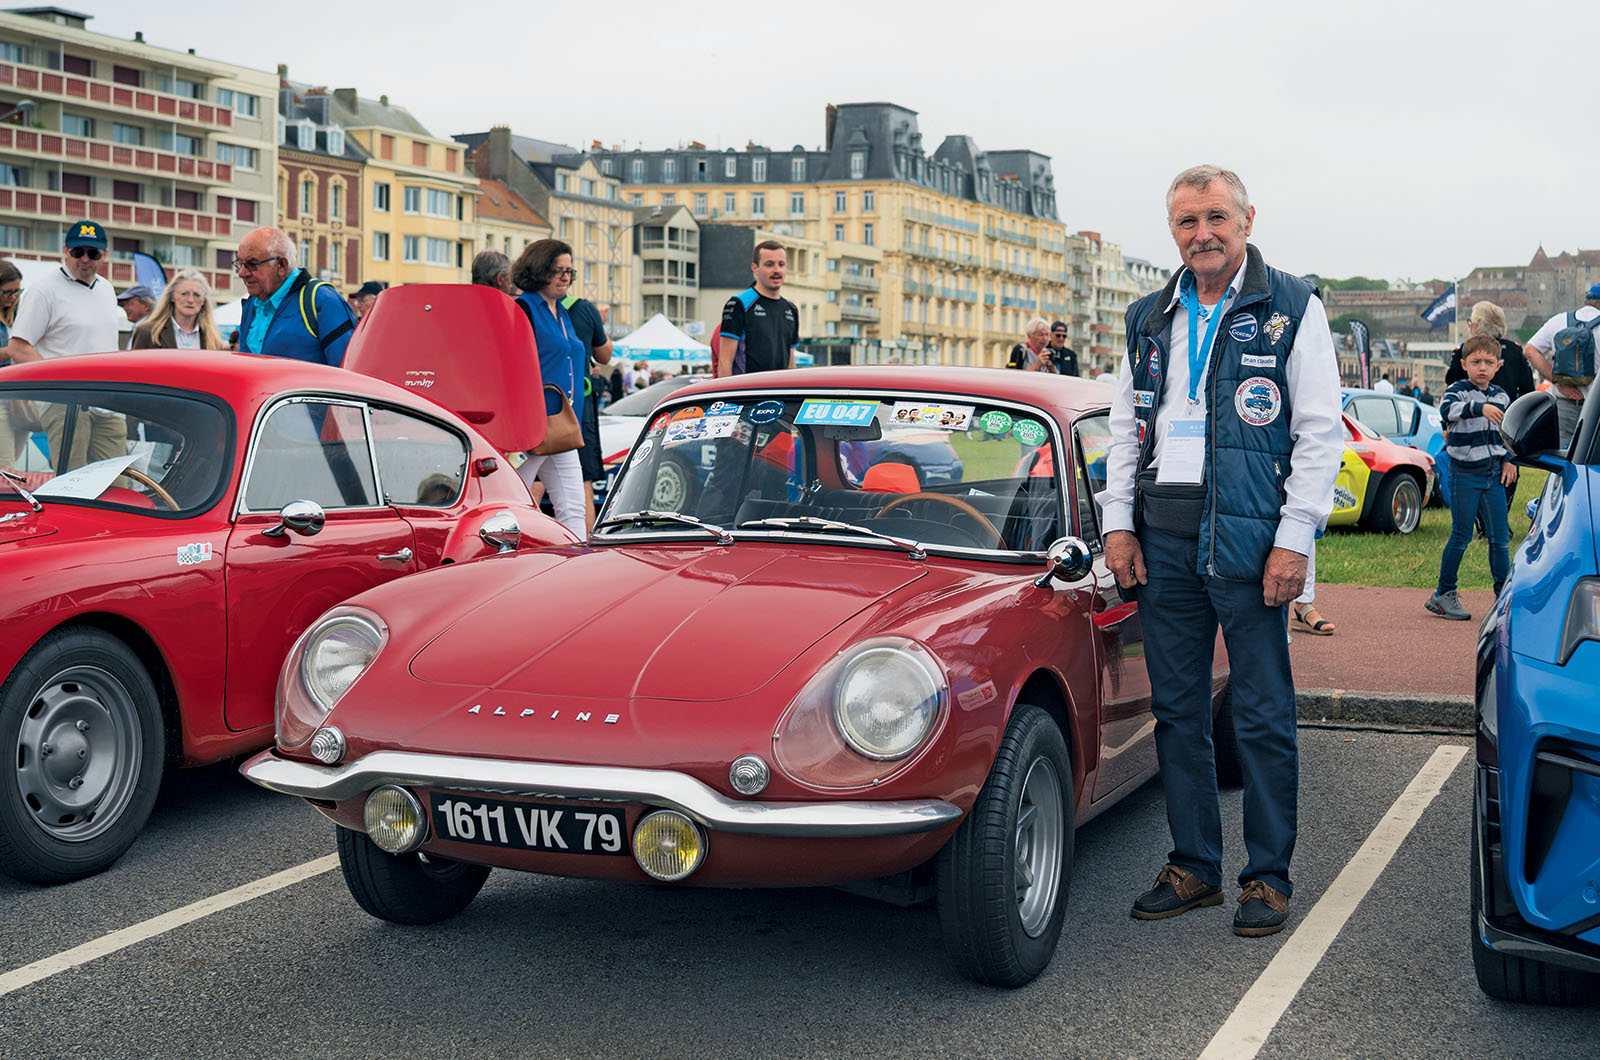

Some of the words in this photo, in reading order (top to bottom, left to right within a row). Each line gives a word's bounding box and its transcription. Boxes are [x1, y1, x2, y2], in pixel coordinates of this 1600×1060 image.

[80, 225, 96, 236] M
[711, 402, 722, 411] 32
[803, 404, 832, 419] EU
[832, 405, 872, 420] 047
[1020, 423, 1039, 431] EXPO
[467, 703, 621, 724] ALPINE
[438, 800, 509, 844] 1611
[514, 807, 569, 849] VK
[575, 813, 622, 852] 79
